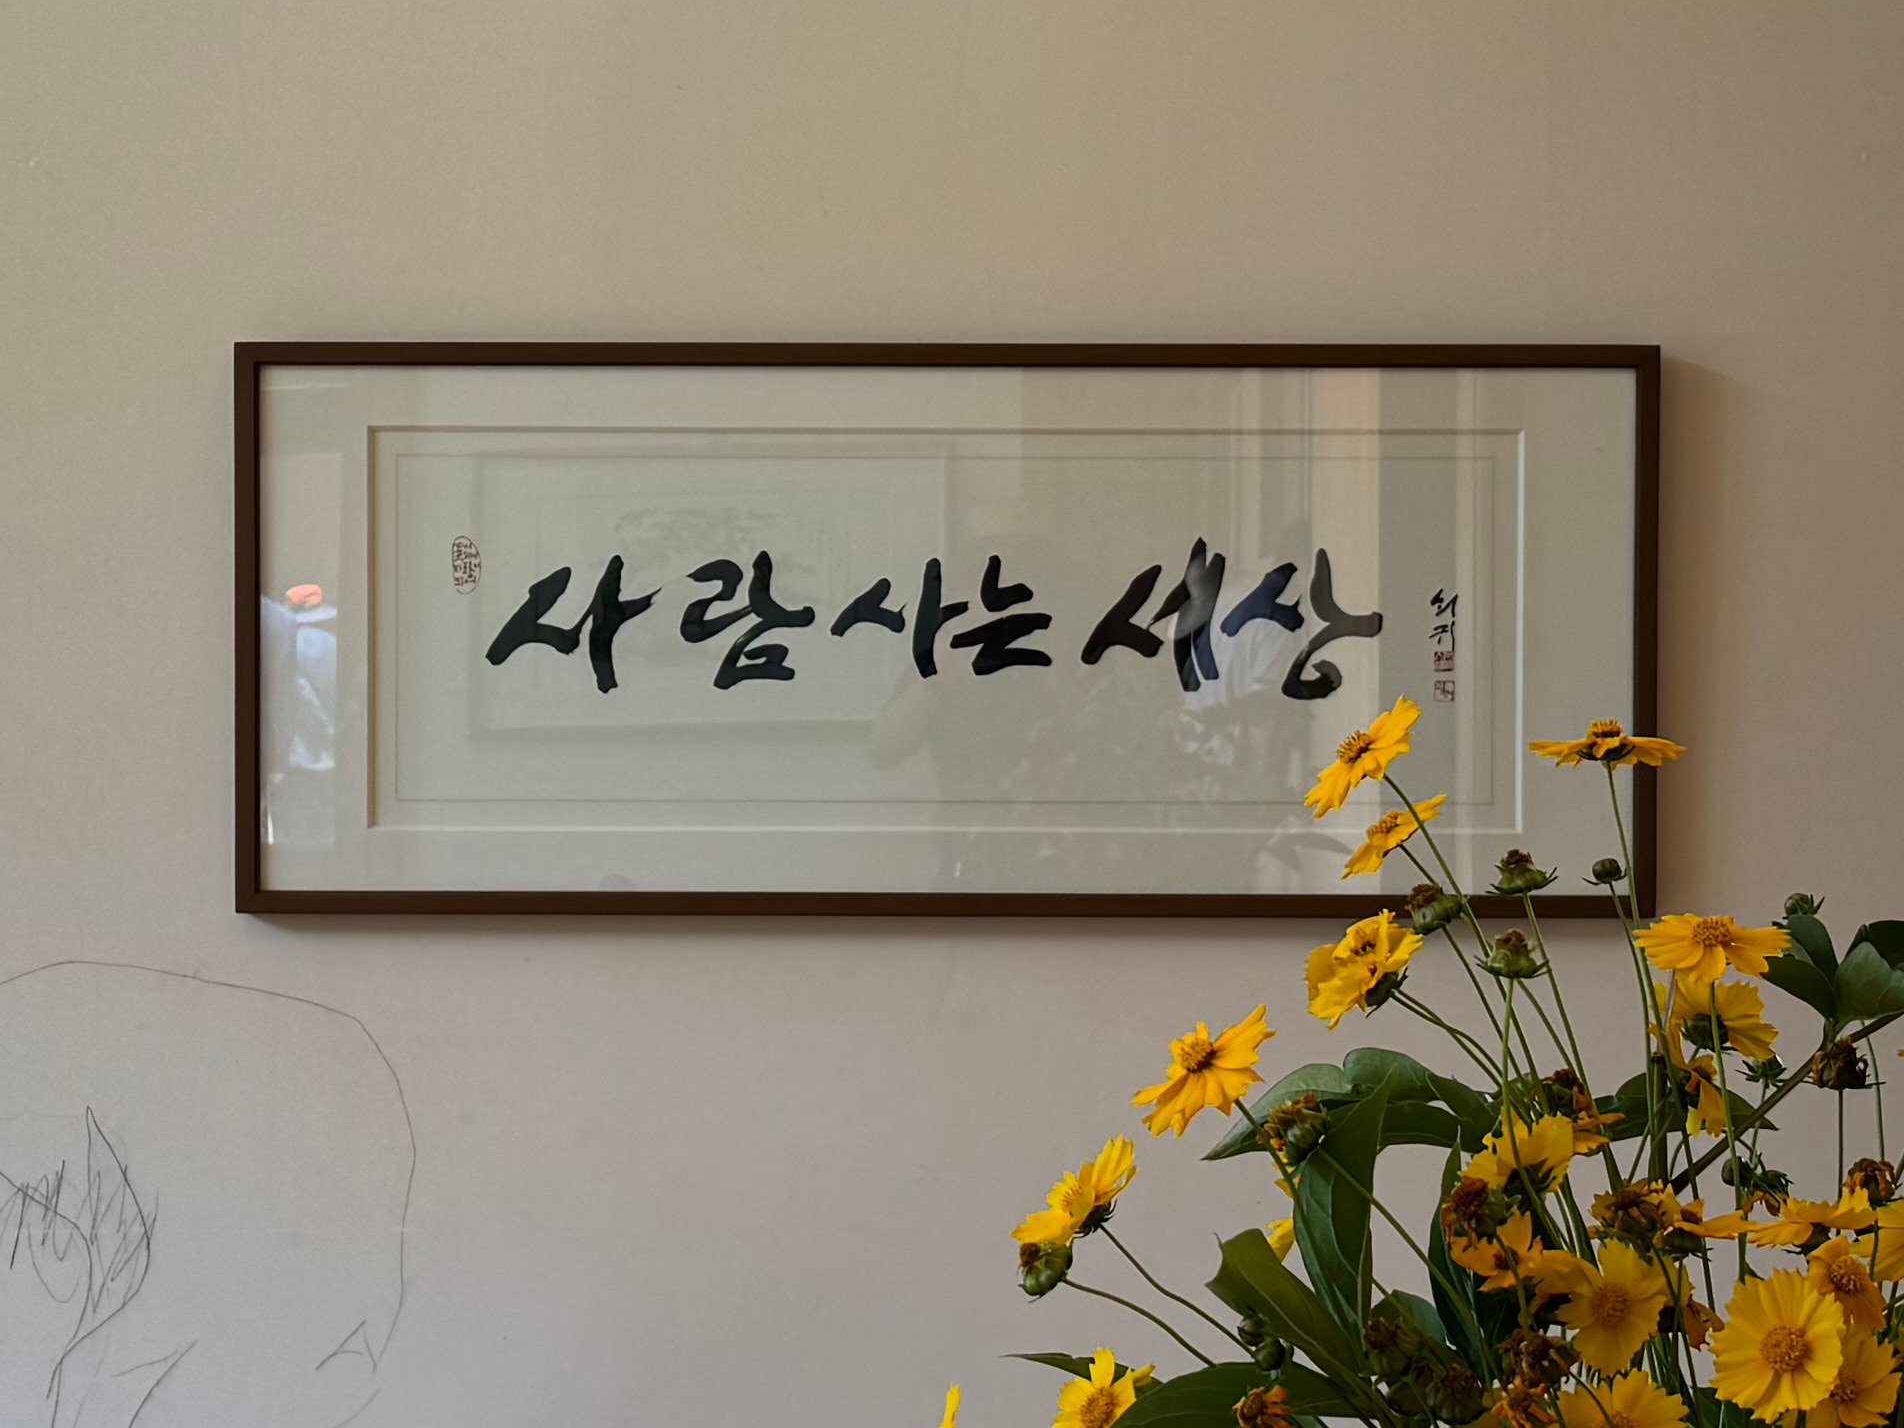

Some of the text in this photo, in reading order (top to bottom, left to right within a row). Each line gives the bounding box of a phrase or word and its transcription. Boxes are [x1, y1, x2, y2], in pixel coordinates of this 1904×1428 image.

[485, 551, 815, 694] 사람
[830, 554, 1053, 679] 사는
[1080, 536, 1384, 701] 세상
